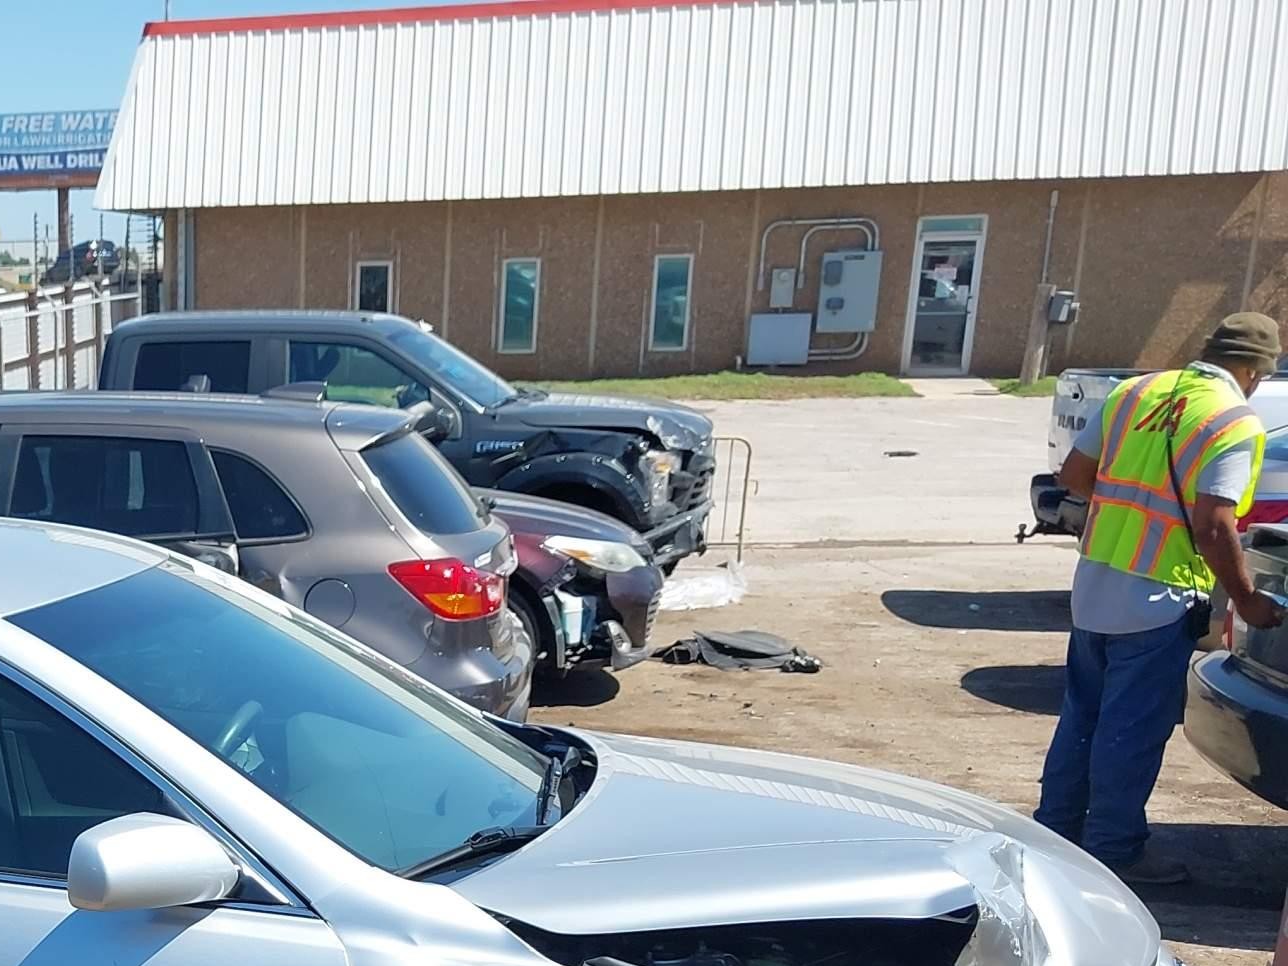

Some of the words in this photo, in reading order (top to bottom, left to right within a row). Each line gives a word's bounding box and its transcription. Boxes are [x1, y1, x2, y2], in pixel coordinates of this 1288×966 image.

[1, 113, 55, 134] FREE
[52, 129, 112, 146] IRRIGATI
[21, 153, 64, 170] WELL
